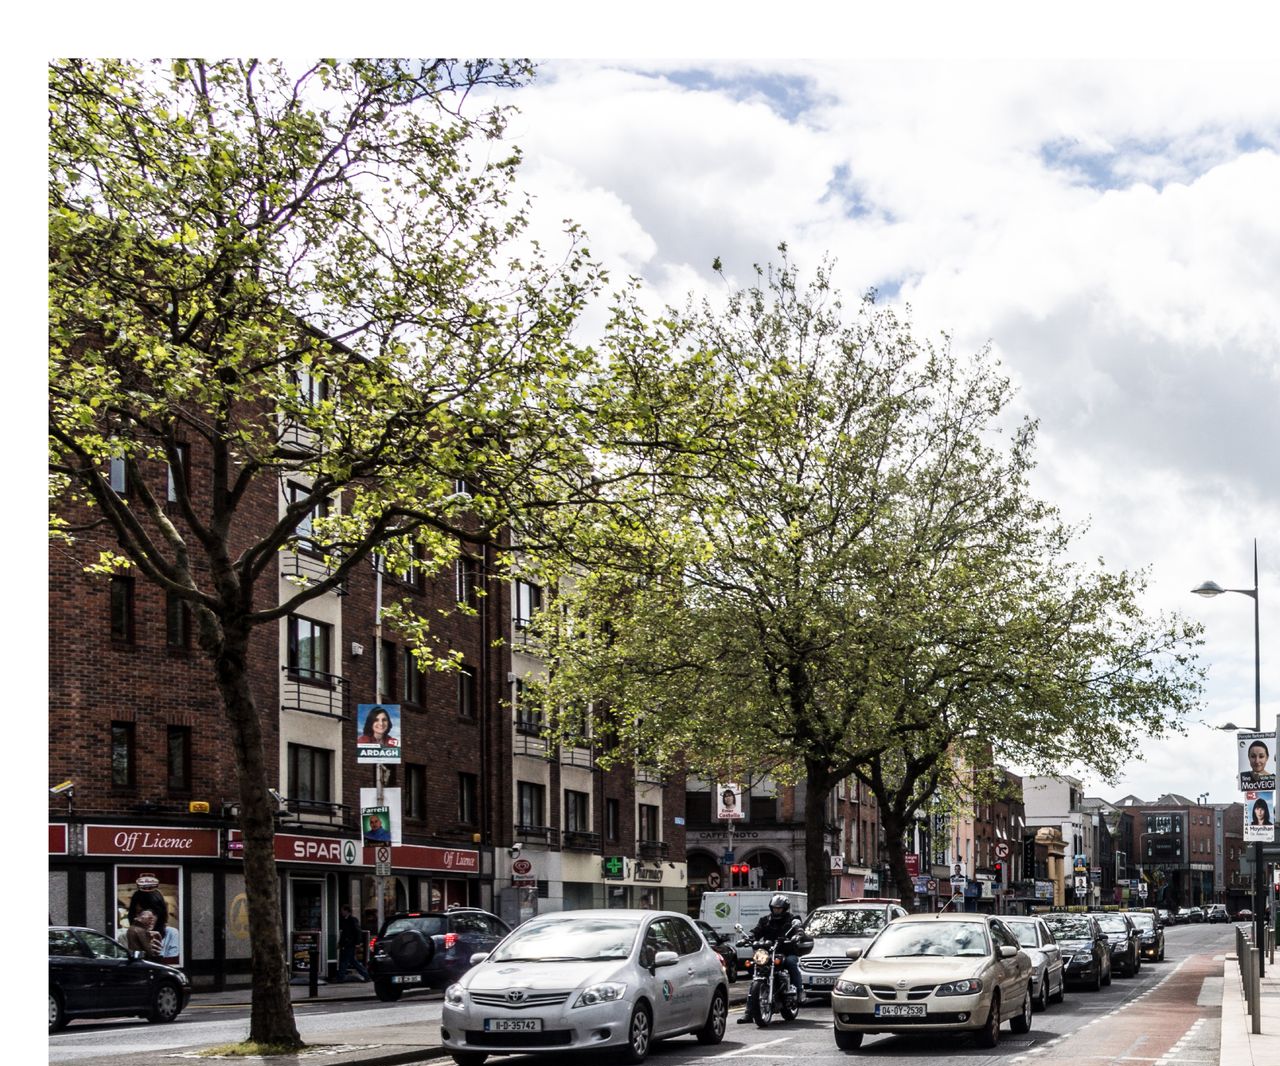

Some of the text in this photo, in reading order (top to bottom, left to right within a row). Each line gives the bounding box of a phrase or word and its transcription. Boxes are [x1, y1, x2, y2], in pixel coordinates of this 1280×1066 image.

[114, 831, 193, 852] Off Licence
[294, 841, 340, 859] SPAR
[444, 852, 475, 868] Off Licence
[495, 1020, 536, 1030] 11-D-35742
